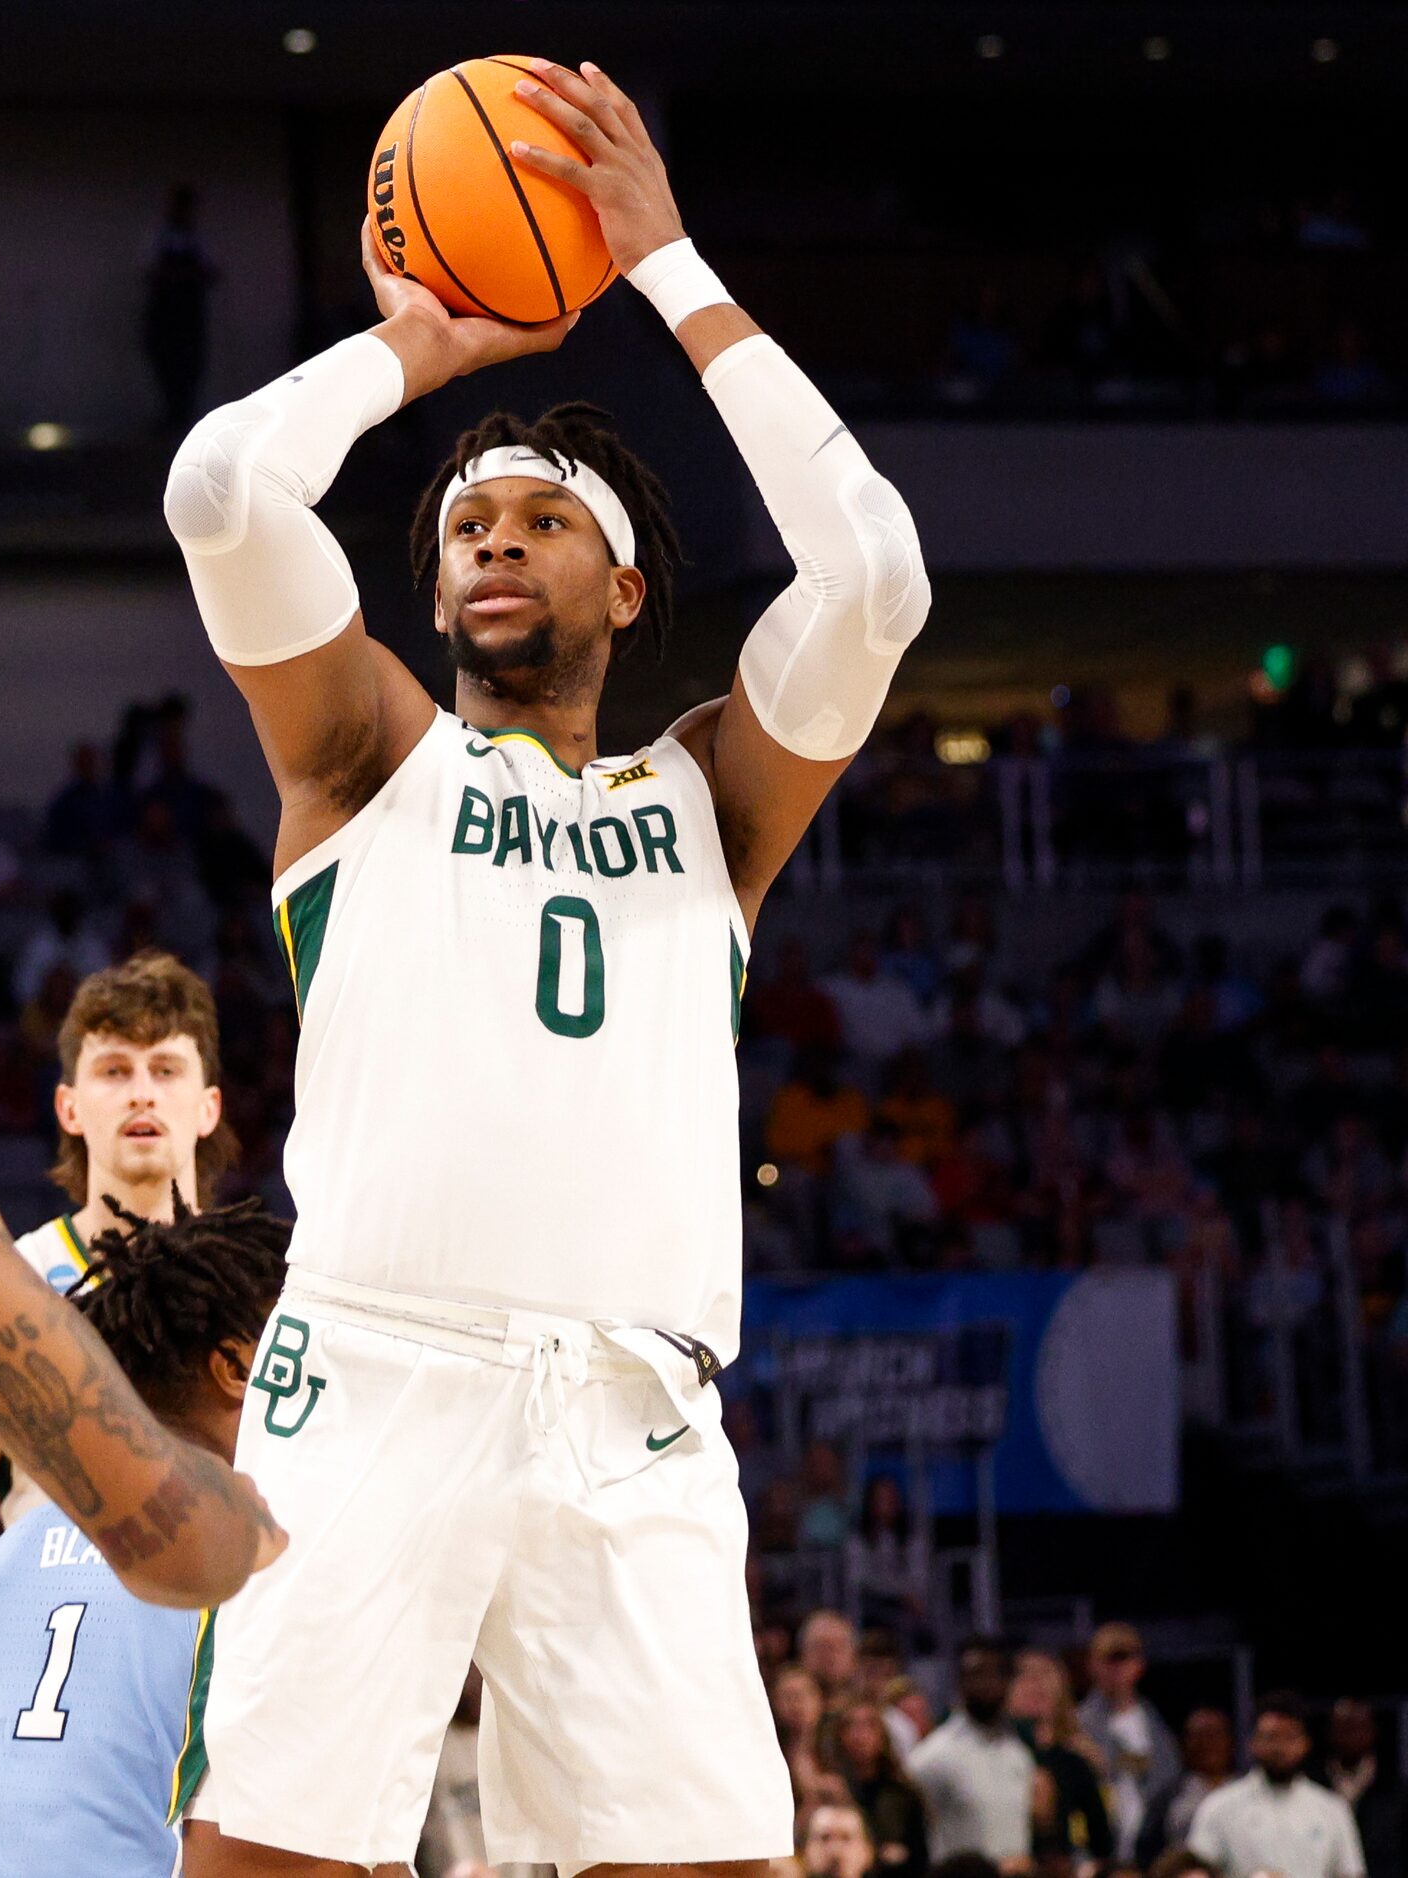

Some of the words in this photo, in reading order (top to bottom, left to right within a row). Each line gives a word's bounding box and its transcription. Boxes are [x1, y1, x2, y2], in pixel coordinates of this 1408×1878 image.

[451, 785, 685, 878] BAYLOR
[602, 760, 655, 790] XII
[535, 895, 605, 1038] 0
[13, 1602, 88, 1741] 1
